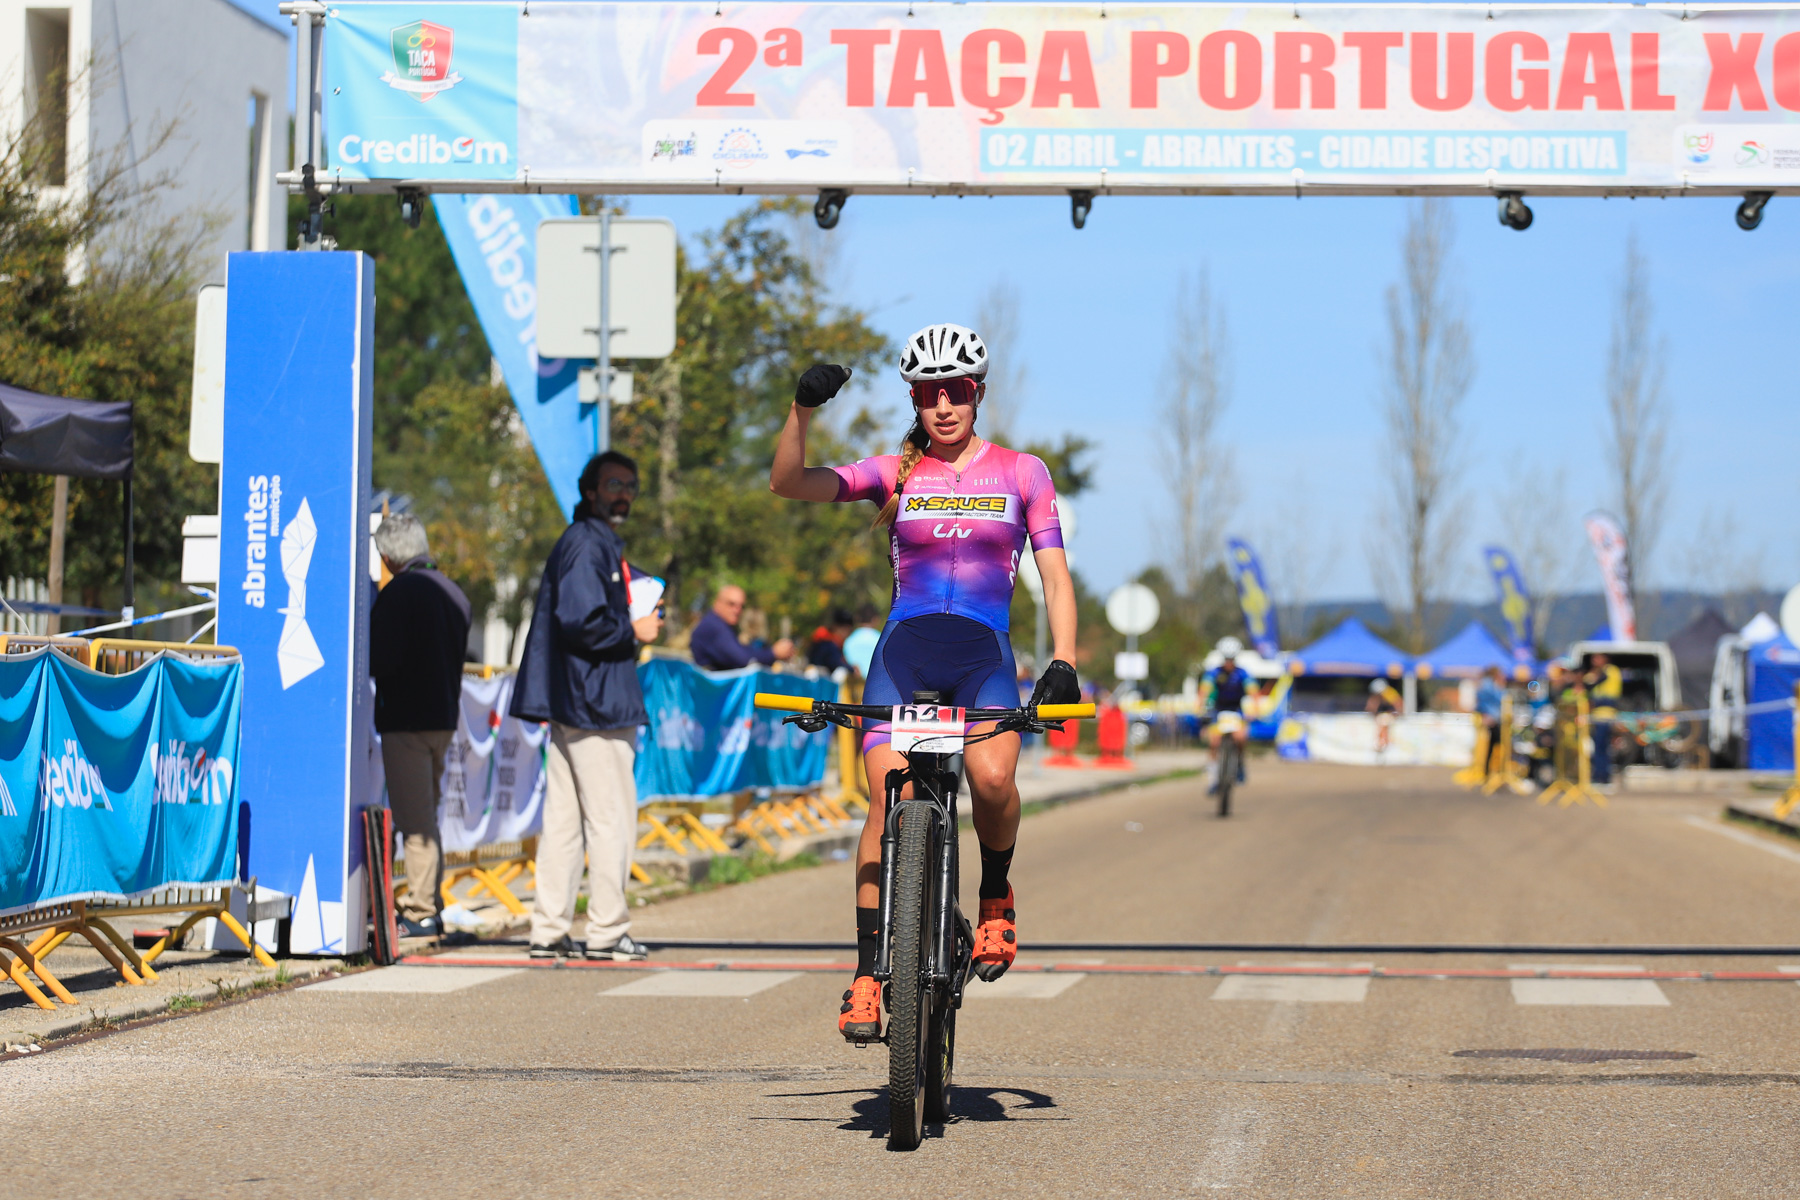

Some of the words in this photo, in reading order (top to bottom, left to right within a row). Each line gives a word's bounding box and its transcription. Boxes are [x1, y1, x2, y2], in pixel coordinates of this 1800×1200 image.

[830, 29, 1100, 126] TAÇA
[1129, 30, 1676, 112] PORTUGAL
[338, 133, 508, 165] Credibom
[987, 135, 1026, 167] 02
[1033, 135, 1119, 167] ABRIL
[1142, 135, 1296, 168] ABRANTES
[1319, 136, 1428, 168] CIDADE
[1434, 136, 1619, 169] DESPORTIVA
[905, 496, 1006, 513] X-SAUCE
[242, 475, 269, 609] abrantes
